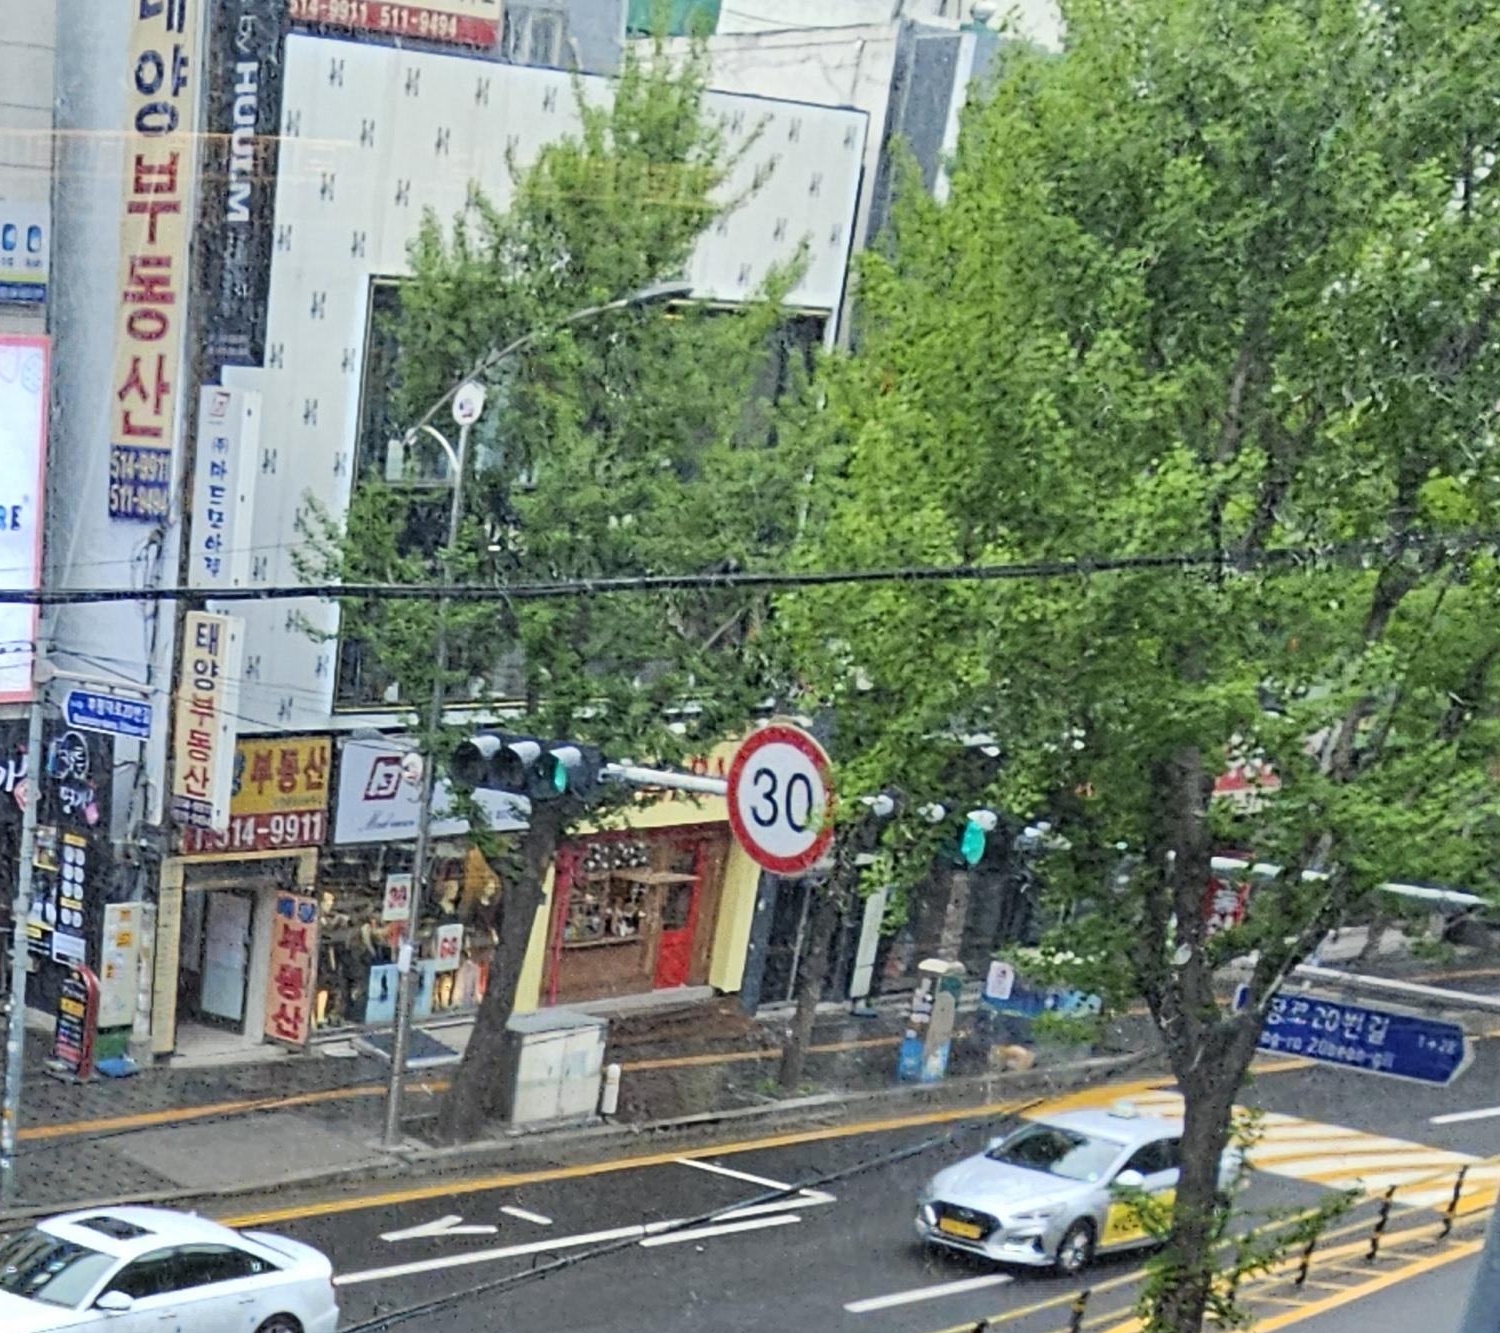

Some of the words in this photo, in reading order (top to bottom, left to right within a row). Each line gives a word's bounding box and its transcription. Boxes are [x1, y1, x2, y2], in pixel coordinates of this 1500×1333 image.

[183, 622, 220, 798] 태양부동산
[251, 745, 327, 796] 부동산
[752, 767, 814, 833] 30
[271, 923, 309, 1041] 부동산
